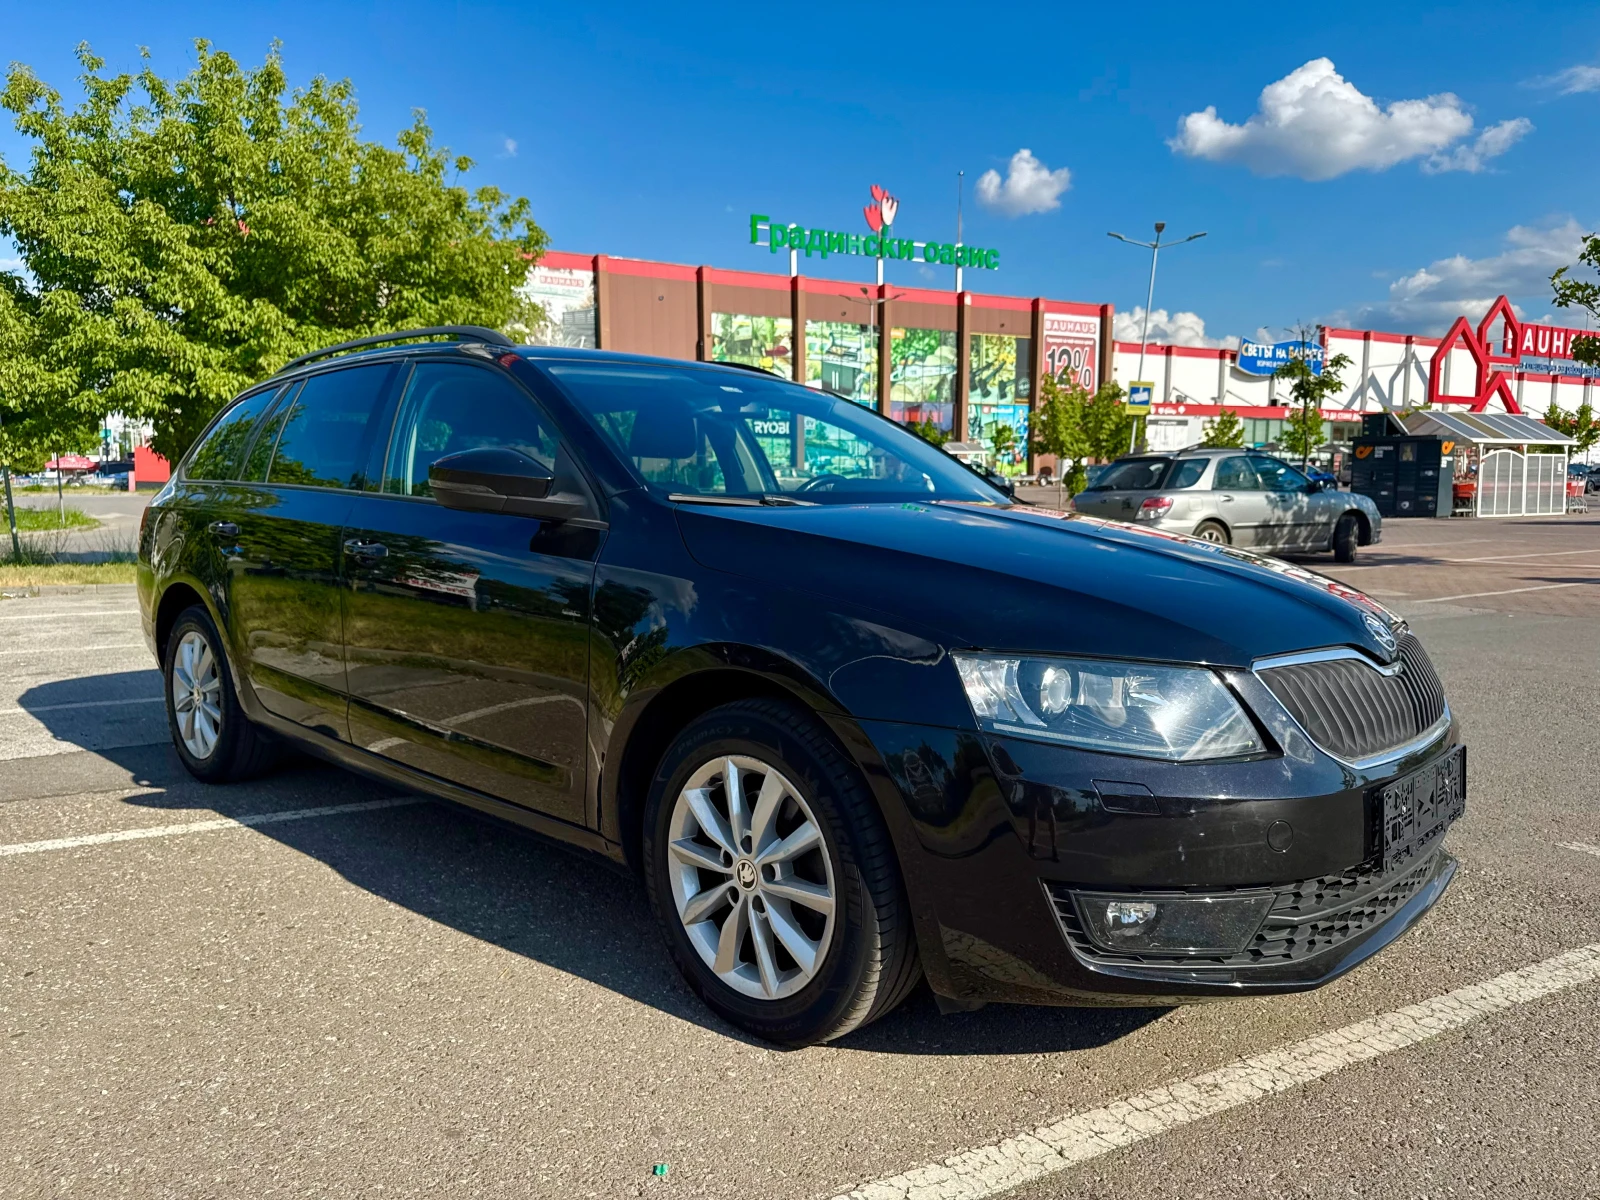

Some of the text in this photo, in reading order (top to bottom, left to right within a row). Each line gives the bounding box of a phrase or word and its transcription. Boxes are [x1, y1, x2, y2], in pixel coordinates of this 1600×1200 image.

[750, 214, 999, 270] Градински оазис
[1045, 320, 1096, 334] BAUHAUS
[1242, 343, 1274, 358] СВЕТЪТ
[1276, 348, 1287, 358] НА
[1046, 347, 1092, 389] 12%
[753, 421, 790, 434] RYOBI
[677, 725, 751, 755] PRIMACY 3
